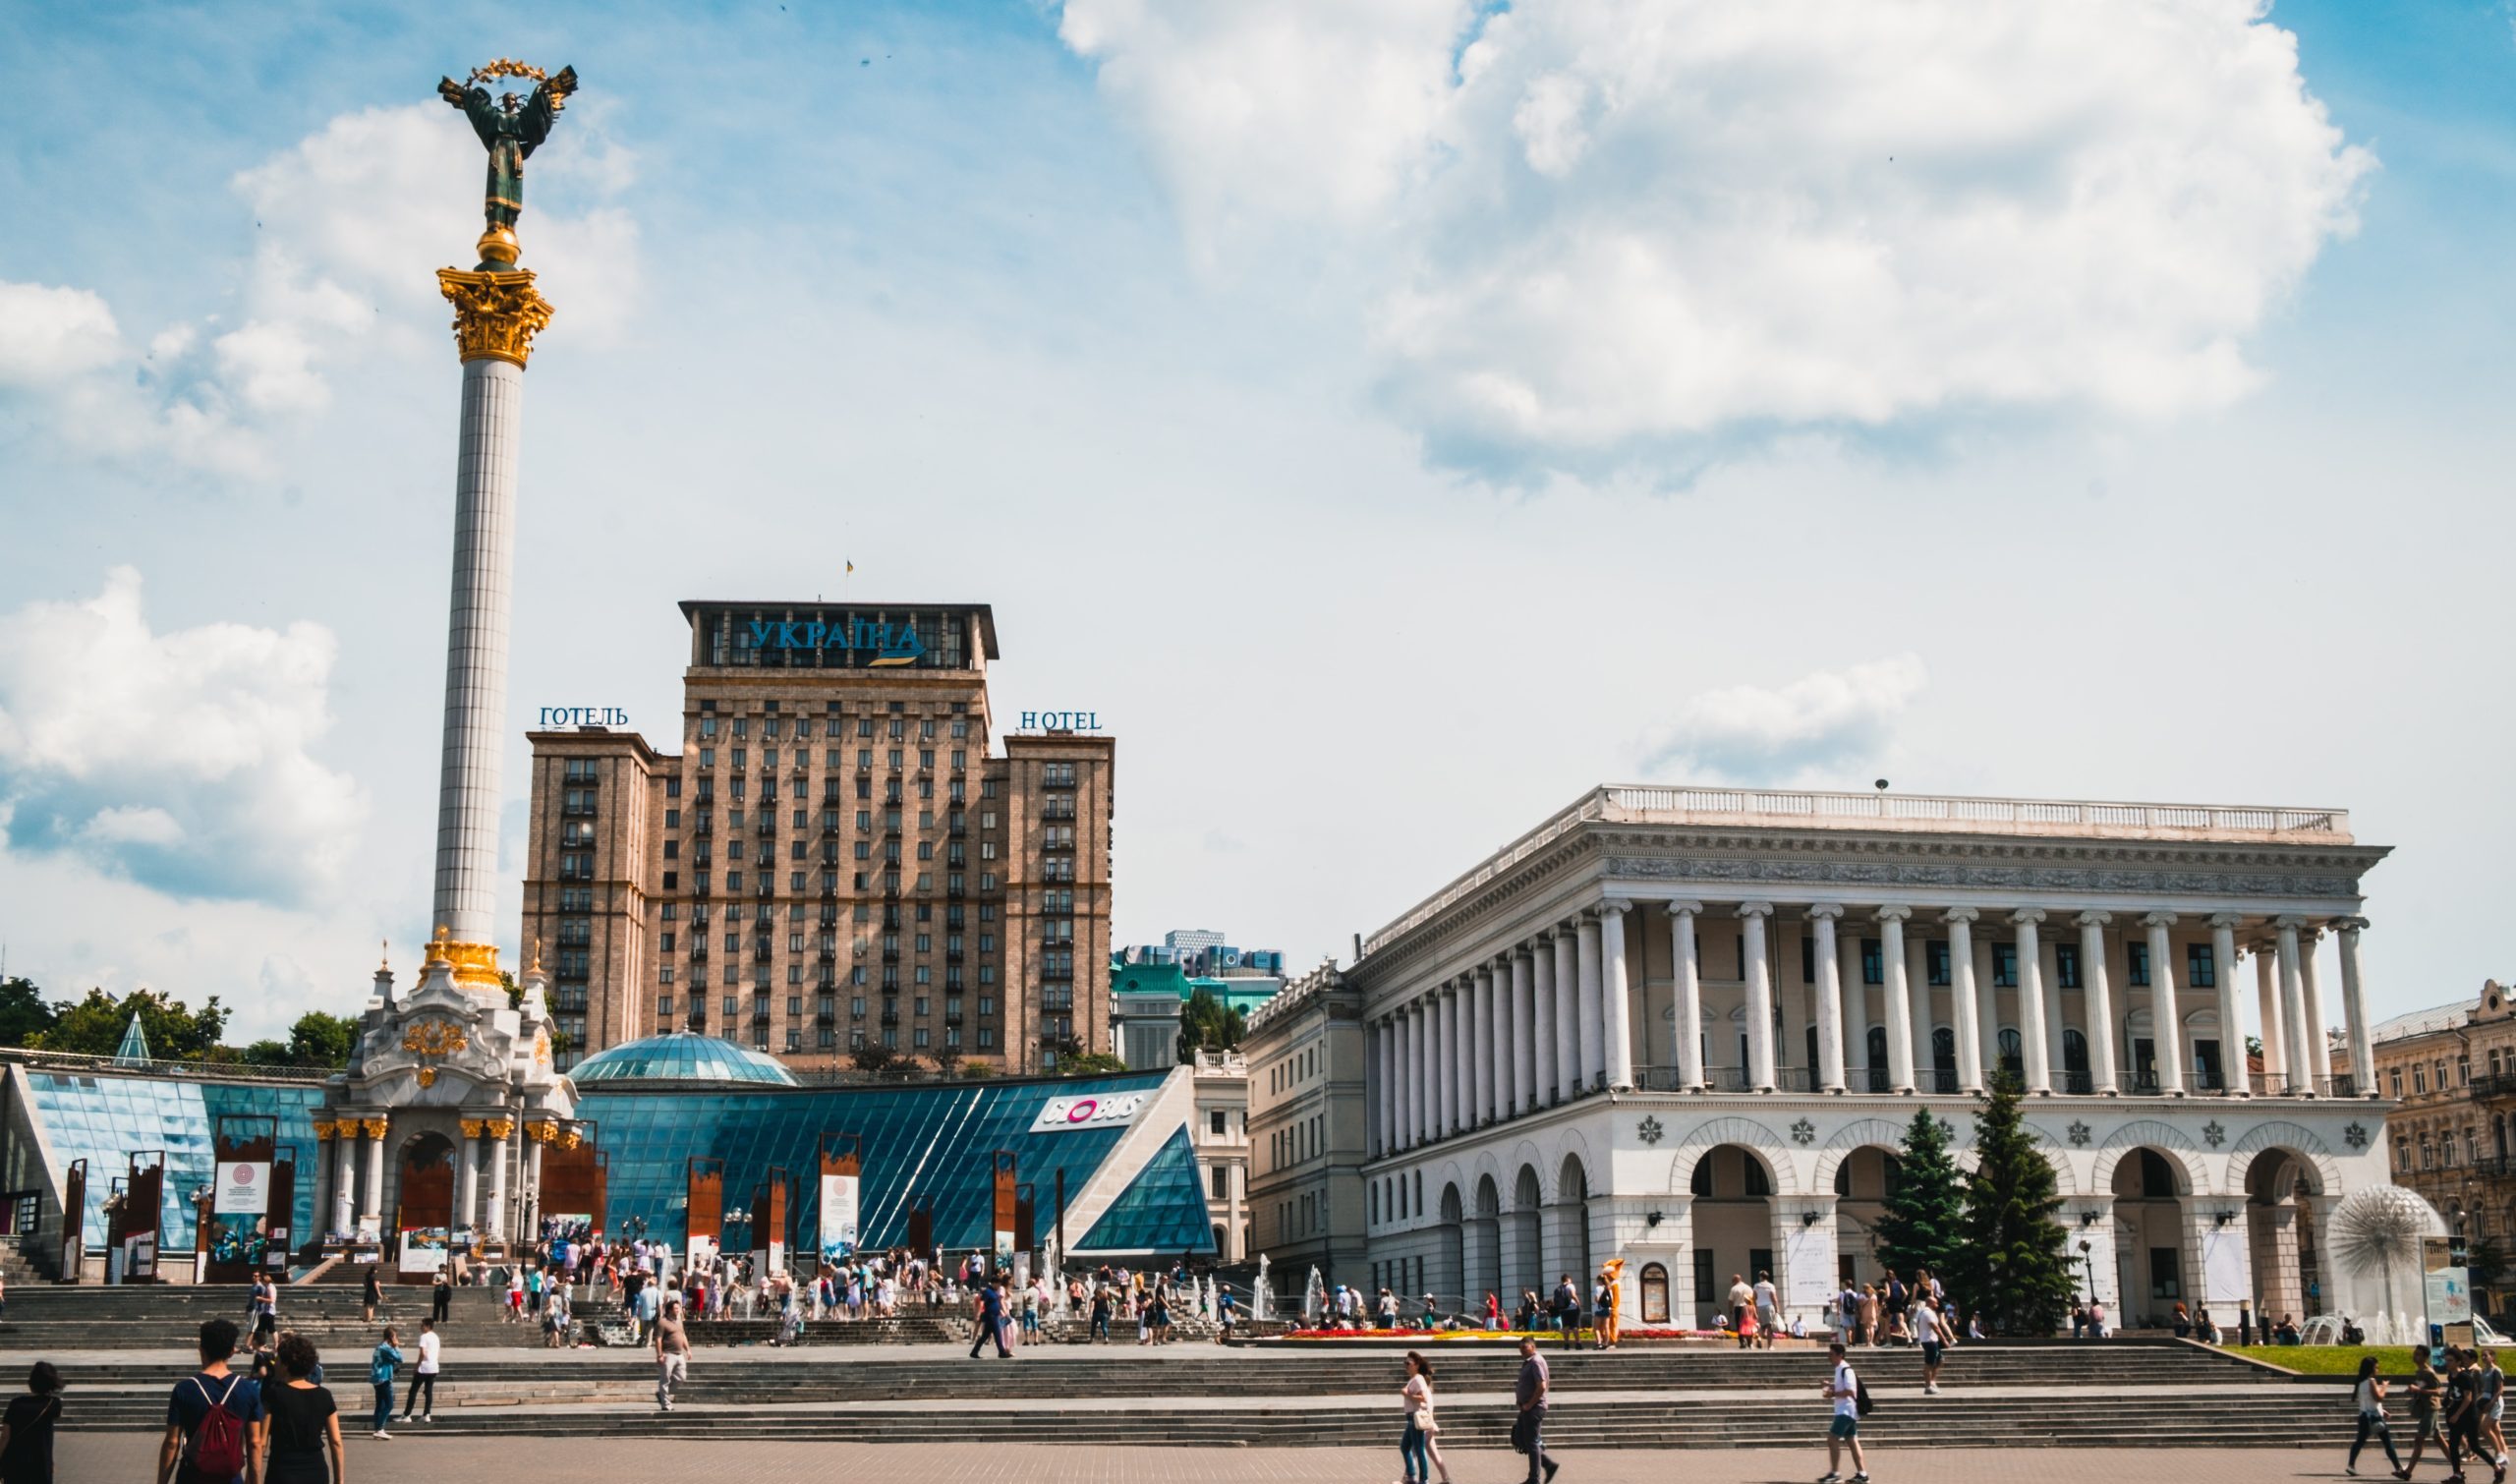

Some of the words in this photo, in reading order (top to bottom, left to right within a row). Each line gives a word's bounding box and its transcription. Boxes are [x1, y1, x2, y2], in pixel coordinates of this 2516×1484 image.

[749, 617, 926, 650] УКРАЇНА
[540, 707, 629, 725] ГОТЕЛЬ
[1021, 712, 1103, 730] HOTEL
[1043, 1095, 1144, 1124] GLOBUS
